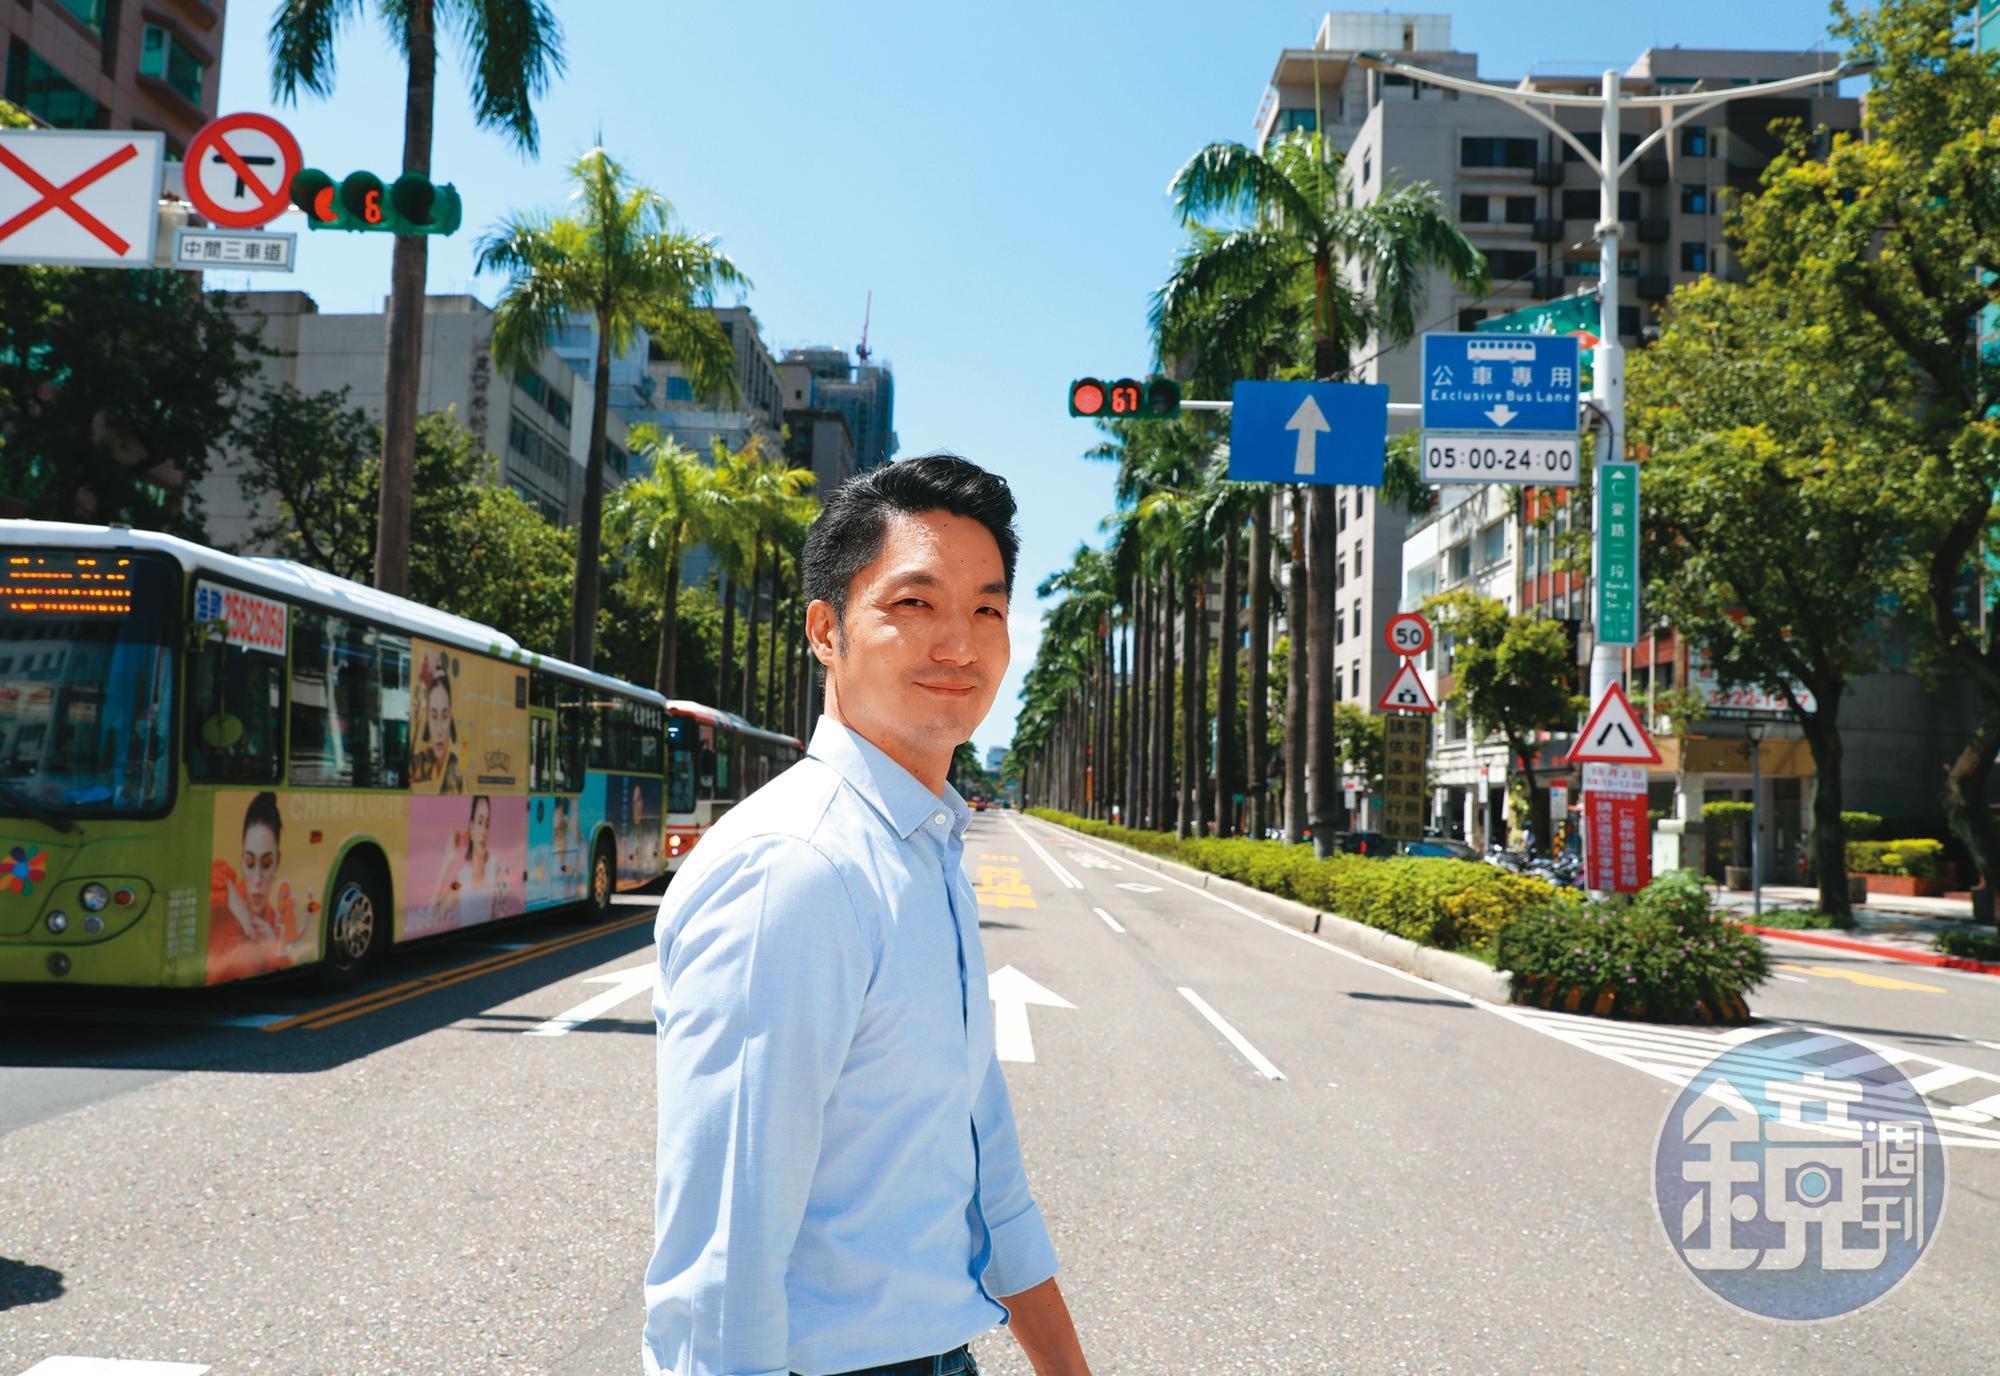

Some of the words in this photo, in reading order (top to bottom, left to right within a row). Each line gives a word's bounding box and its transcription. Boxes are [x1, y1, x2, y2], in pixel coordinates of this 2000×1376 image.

[184, 240, 281, 260] 中間三車道
[1432, 365, 1572, 388] 公車專用
[1112, 387, 1137, 413] 67
[1431, 389, 1502, 402] Exclusive
[1506, 390, 1532, 402] Bus
[1537, 391, 1572, 403] Lane
[1429, 447, 1572, 471] 05:00-24:00
[1396, 628, 1422, 645] 50
